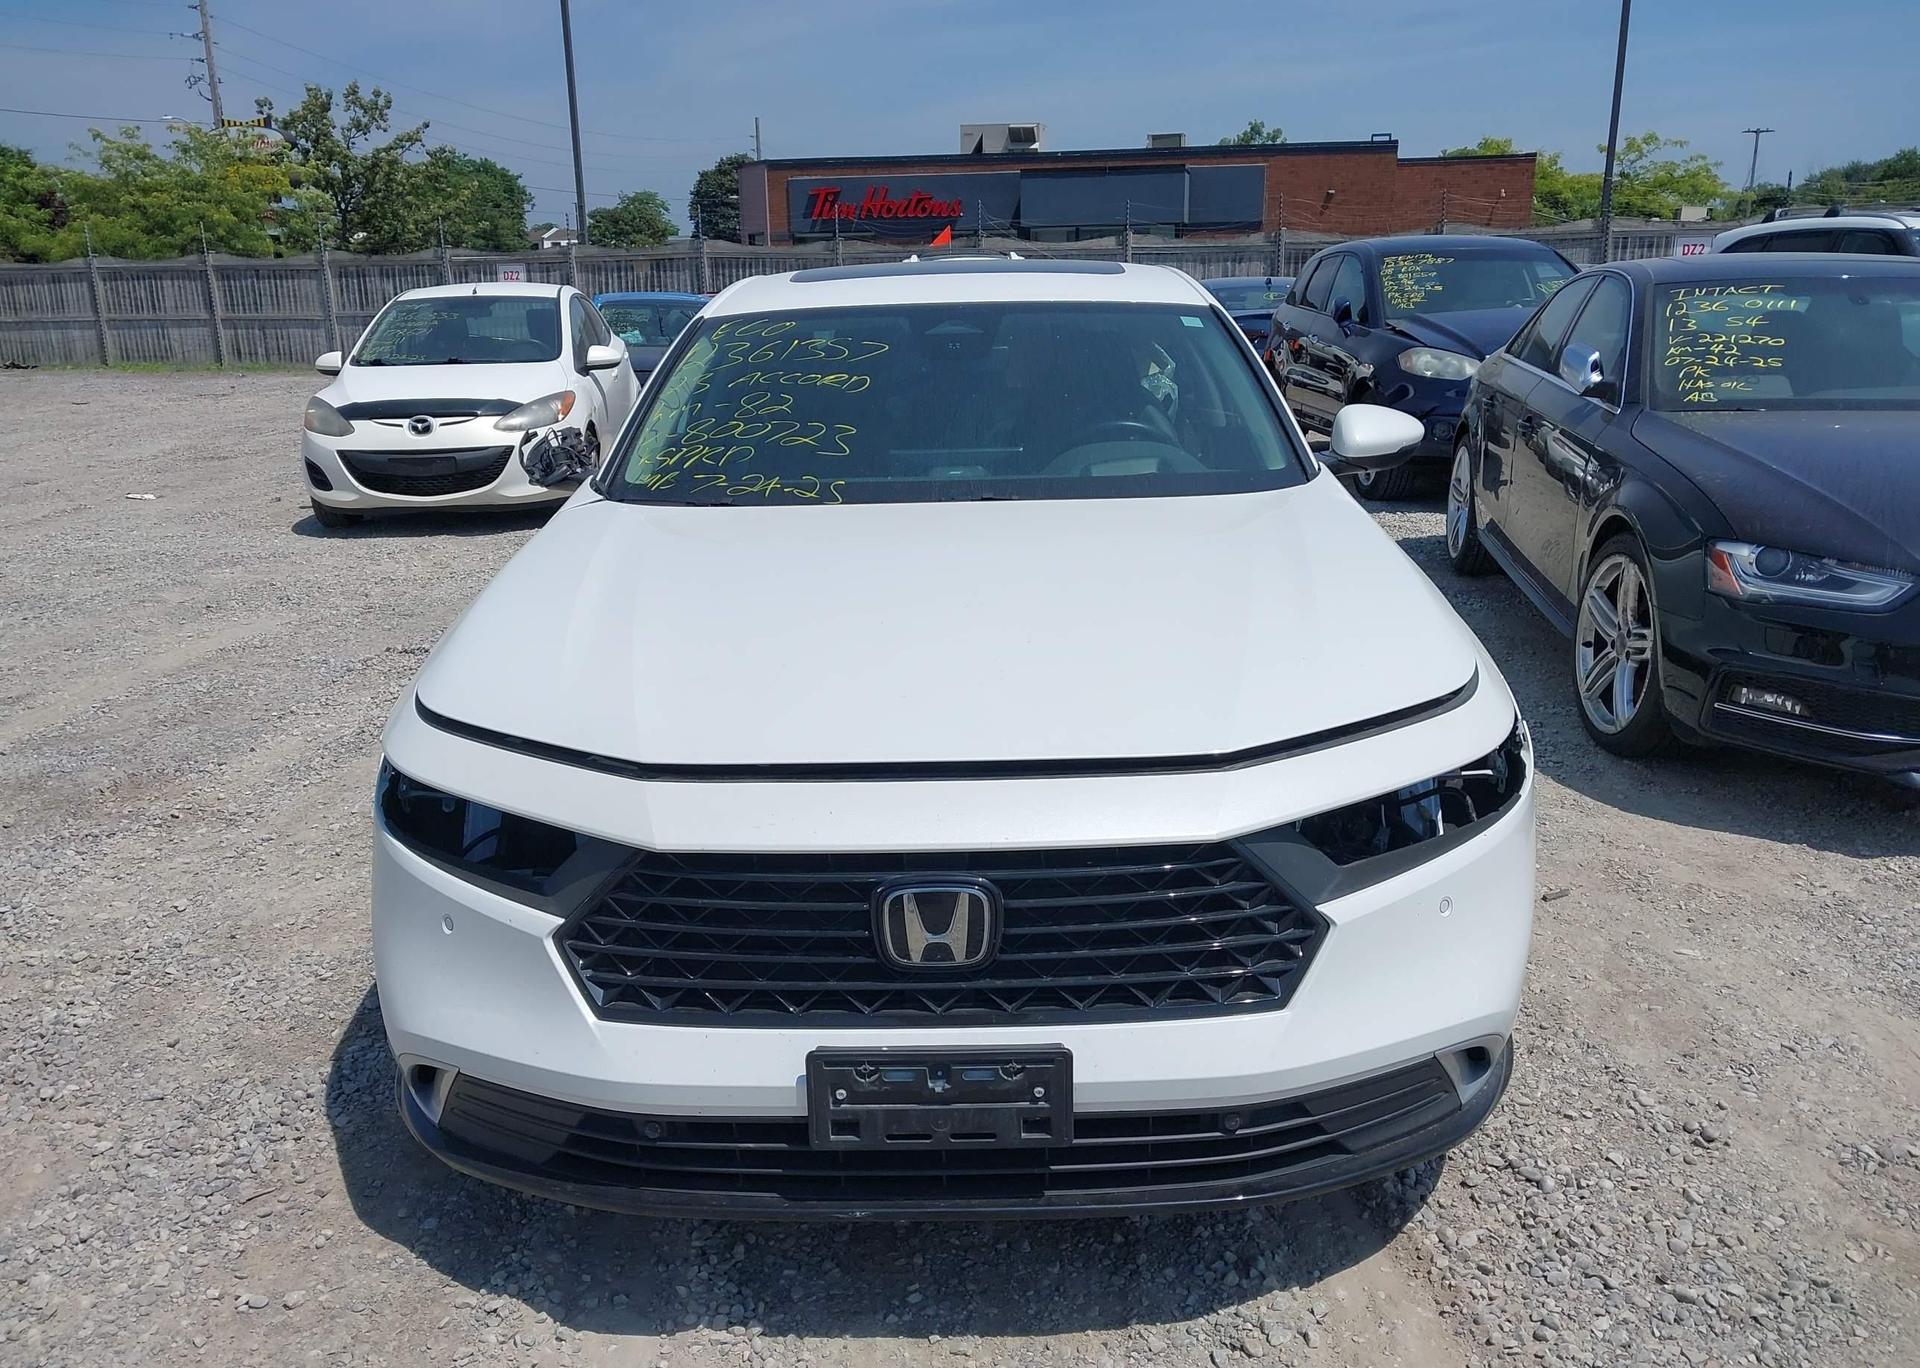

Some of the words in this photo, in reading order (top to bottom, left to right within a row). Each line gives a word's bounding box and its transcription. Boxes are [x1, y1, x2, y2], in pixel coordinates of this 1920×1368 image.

[808, 187, 856, 220] Tim
[860, 184, 960, 219] Hortons
[1682, 244, 1705, 256] DZ2
[503, 271, 520, 281] DZ2
[1670, 284, 1785, 301] INTACT
[1669, 318, 1697, 332] 13
[1664, 355, 1784, 368] 07-24-25
[1679, 366, 1711, 378] PK
[728, 372, 871, 393] ACCORD
[1679, 380, 1715, 391] HAS
[690, 475, 845, 505] 7-24-25
